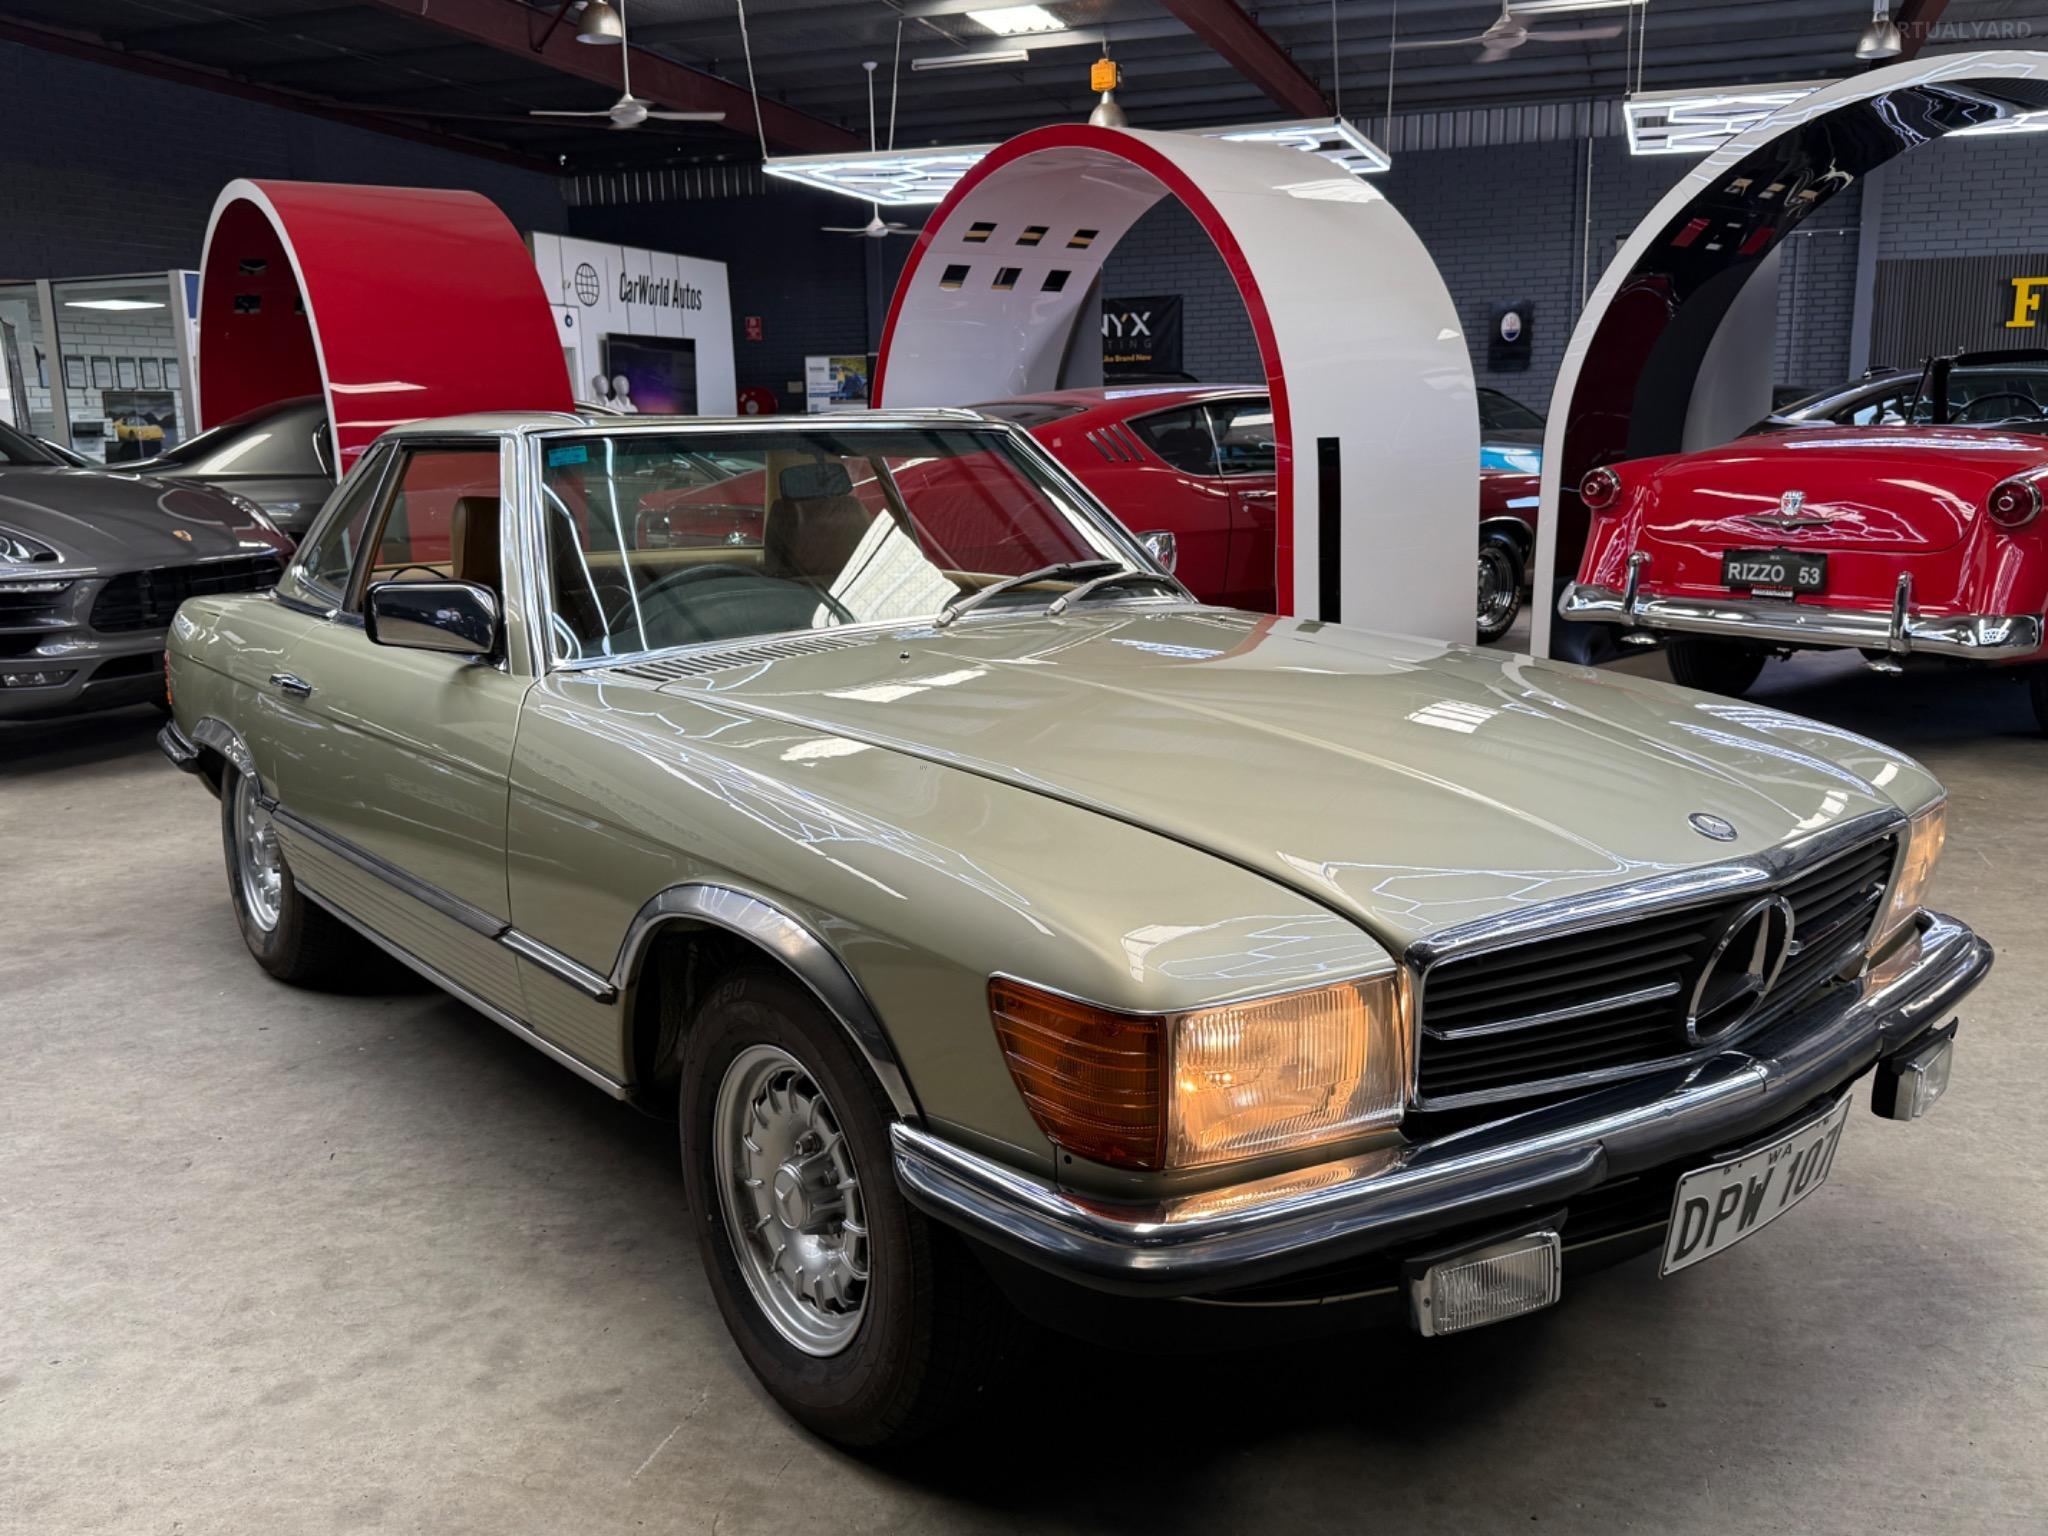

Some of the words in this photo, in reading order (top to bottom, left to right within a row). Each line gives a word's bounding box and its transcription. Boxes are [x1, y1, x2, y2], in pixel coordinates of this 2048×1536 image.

[619, 271, 670, 307] CarWorld
[672, 279, 702, 311] Autos
[1727, 562, 1785, 582] RIZZO
[1798, 566, 1820, 584] 53
[1767, 1142, 1792, 1166] WA
[1672, 1166, 1776, 1262] DPW
[1778, 1122, 1842, 1208] 107
